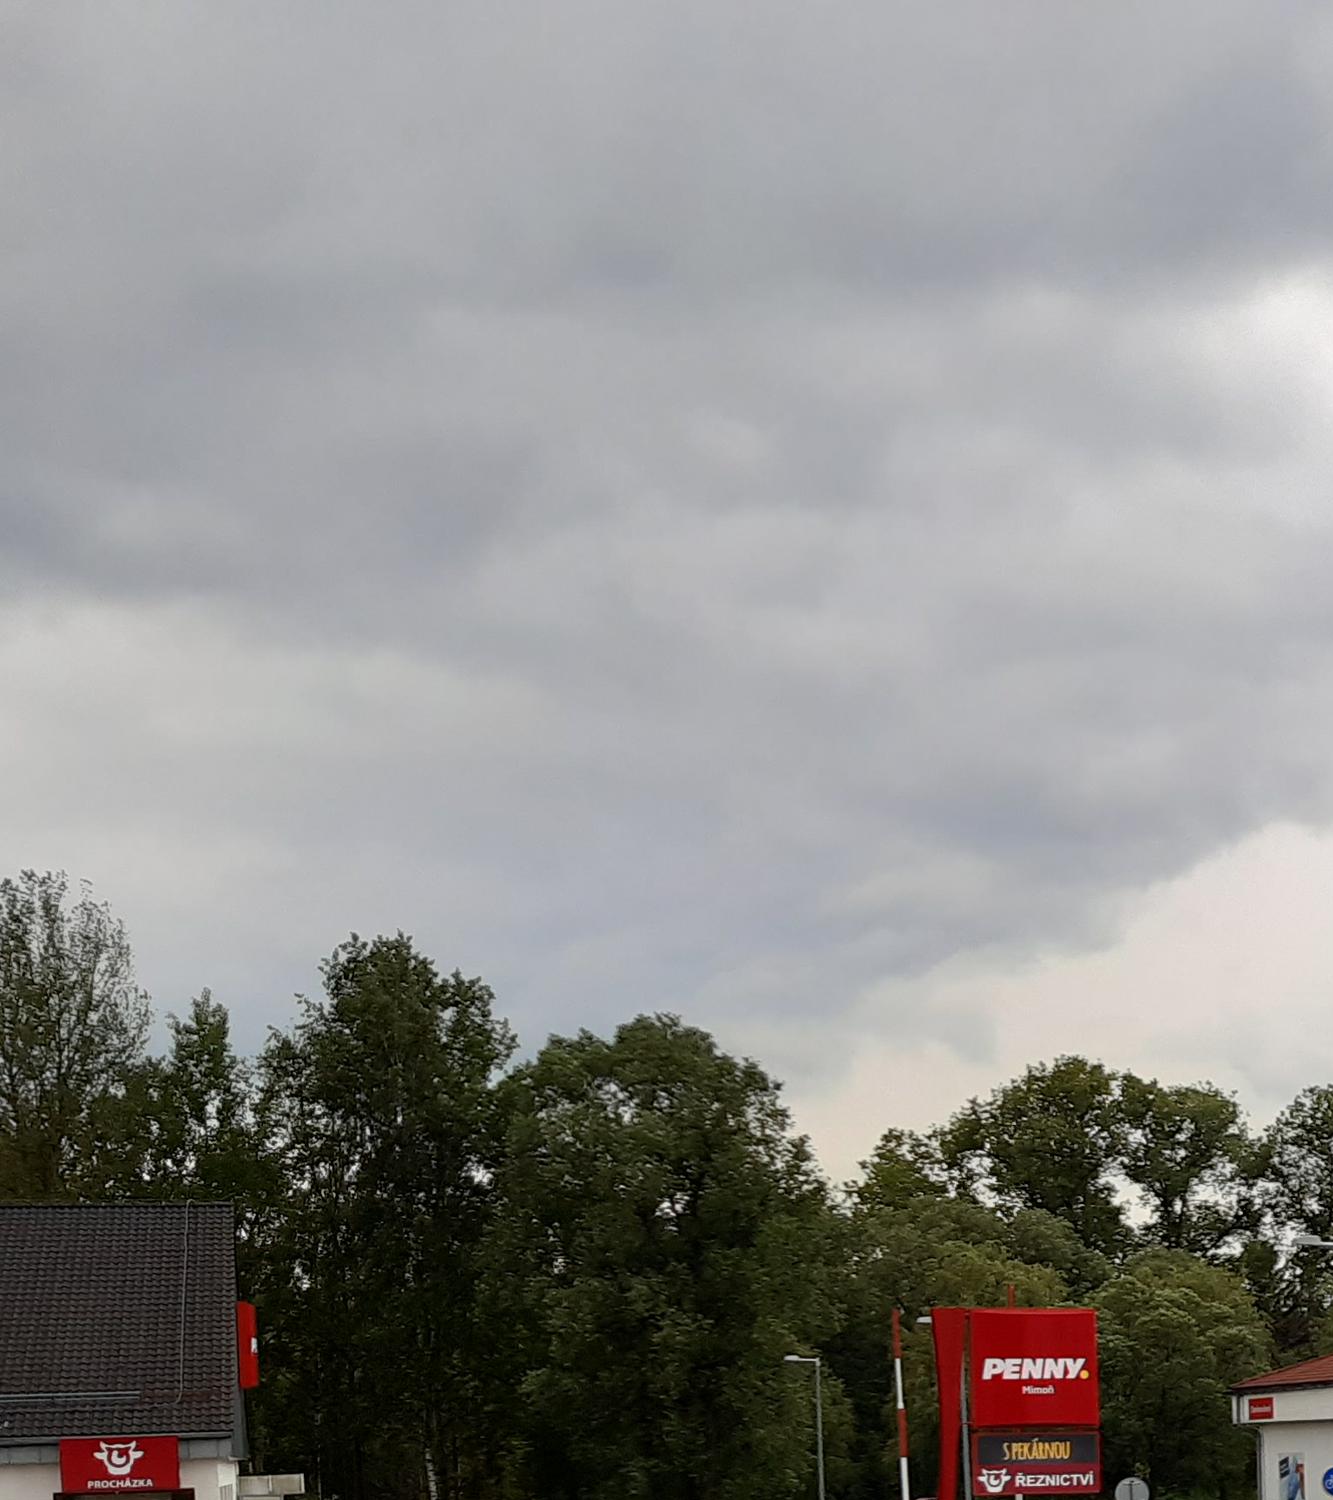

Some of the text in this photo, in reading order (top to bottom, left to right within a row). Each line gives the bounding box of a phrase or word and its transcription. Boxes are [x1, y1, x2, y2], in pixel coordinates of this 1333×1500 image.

[1003, 1438, 1071, 1460] S PEKÁRNOU
[87, 1477, 153, 1489] PROCHÁZKA
[1015, 1471, 1094, 1487] ŘEZNICTVÍ
